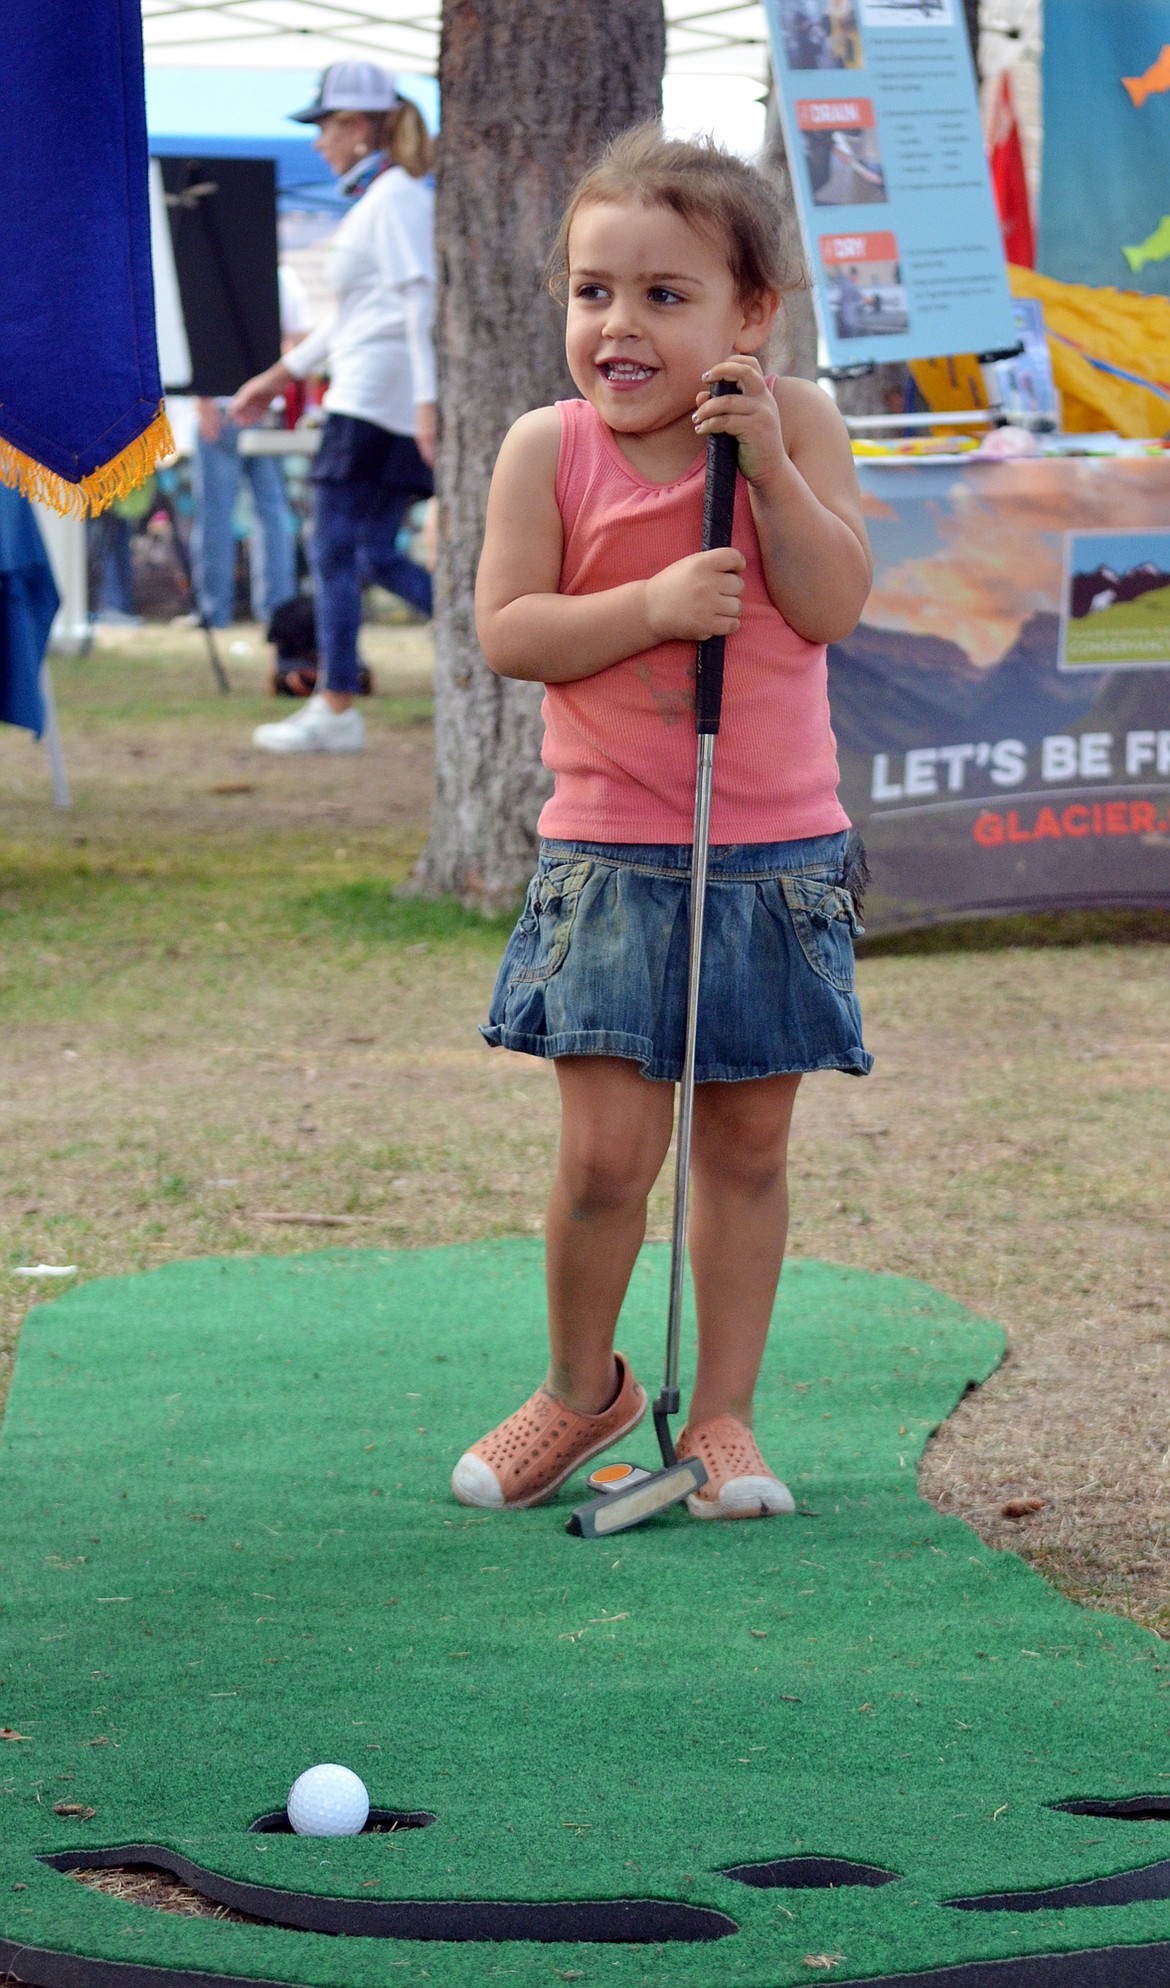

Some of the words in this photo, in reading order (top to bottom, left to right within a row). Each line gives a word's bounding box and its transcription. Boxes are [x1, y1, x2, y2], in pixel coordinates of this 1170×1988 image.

[833, 238, 866, 258] DRY
[871, 739, 1027, 802] LET'S
[1042, 734, 1113, 781] BE
[973, 800, 1170, 847] GLACIER.
